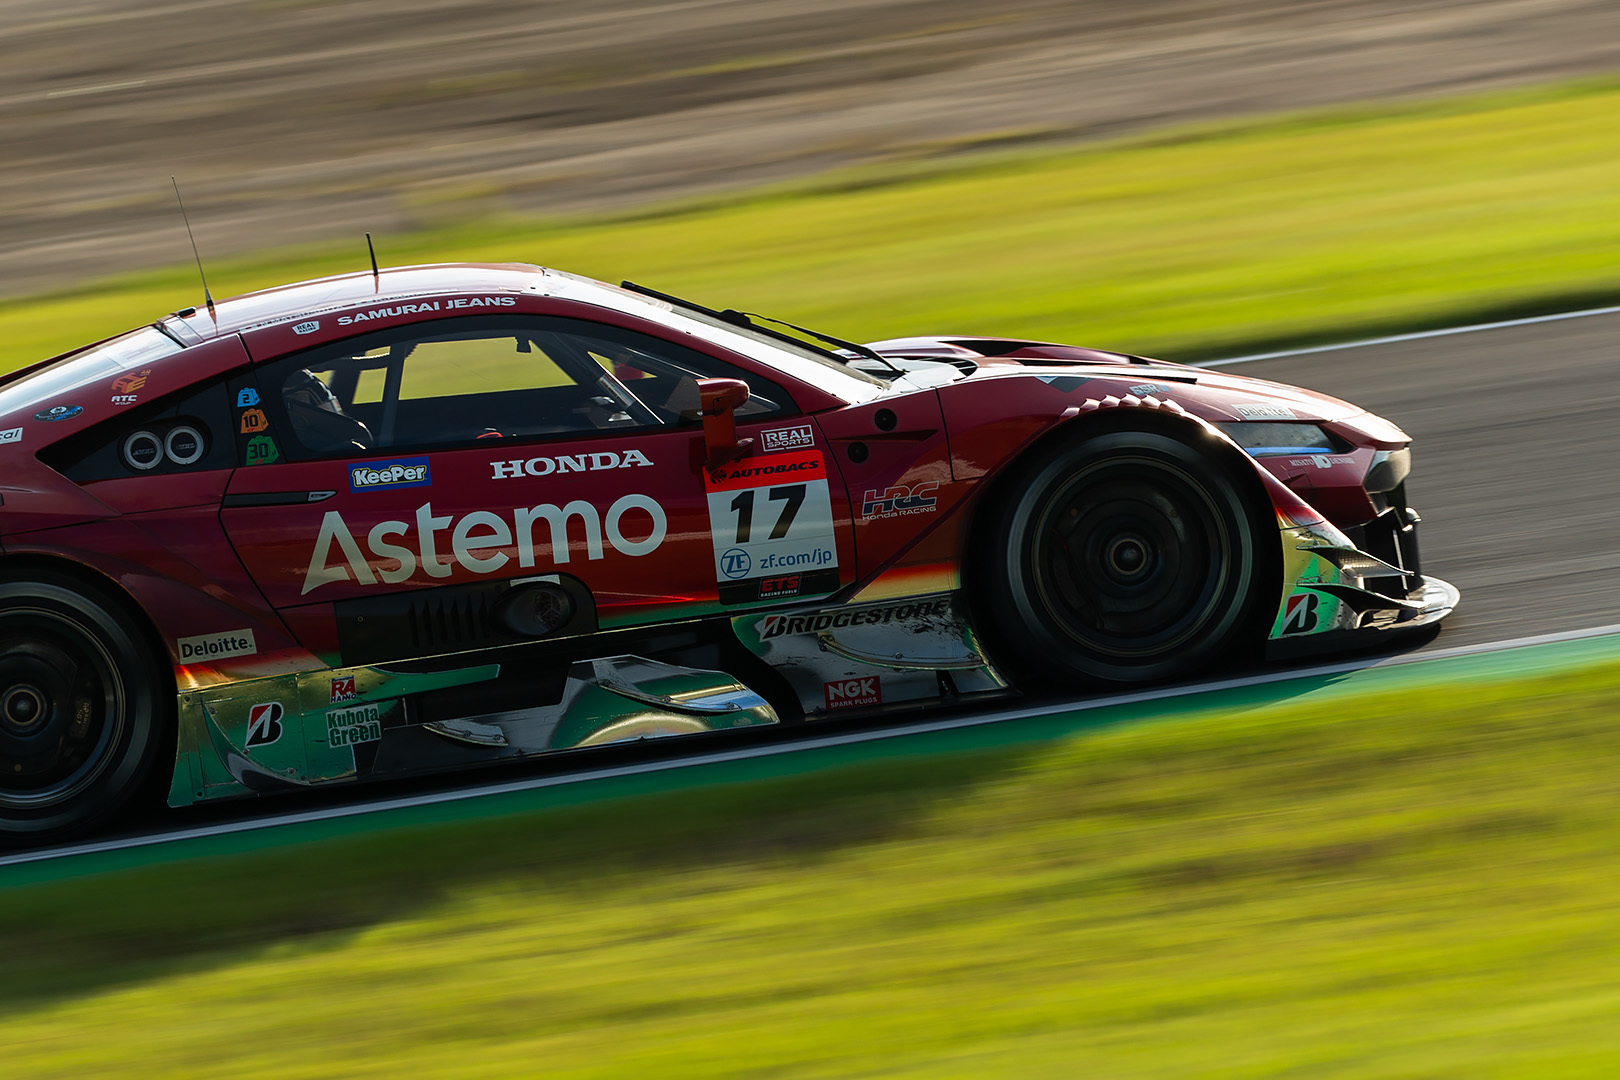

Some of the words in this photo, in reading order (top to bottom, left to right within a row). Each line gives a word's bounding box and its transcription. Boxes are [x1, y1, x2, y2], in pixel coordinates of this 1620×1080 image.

[337, 301, 440, 326] SAMURAI
[445, 296, 516, 310] JEANS
[242, 394, 250, 404] 2
[243, 415, 259, 428] 10
[765, 429, 812, 442] REAL
[767, 437, 810, 448] SPORTS
[248, 443, 269, 459] 30
[491, 450, 654, 480] HONDA
[728, 460, 819, 480] AUTOBACS
[354, 465, 425, 486] KeePer
[730, 484, 807, 544] 17
[862, 512, 898, 521] Honda
[899, 506, 937, 516] RACING
[301, 493, 667, 596] Astemo
[722, 553, 750, 575] ZF
[760, 548, 832, 569] zf.com/jp
[762, 576, 799, 592] ETS
[331, 679, 356, 697] RA
[828, 678, 876, 700] NGK
[830, 699, 854, 708] SPARK
[327, 707, 380, 729] Kubota
[329, 723, 381, 747] Green
